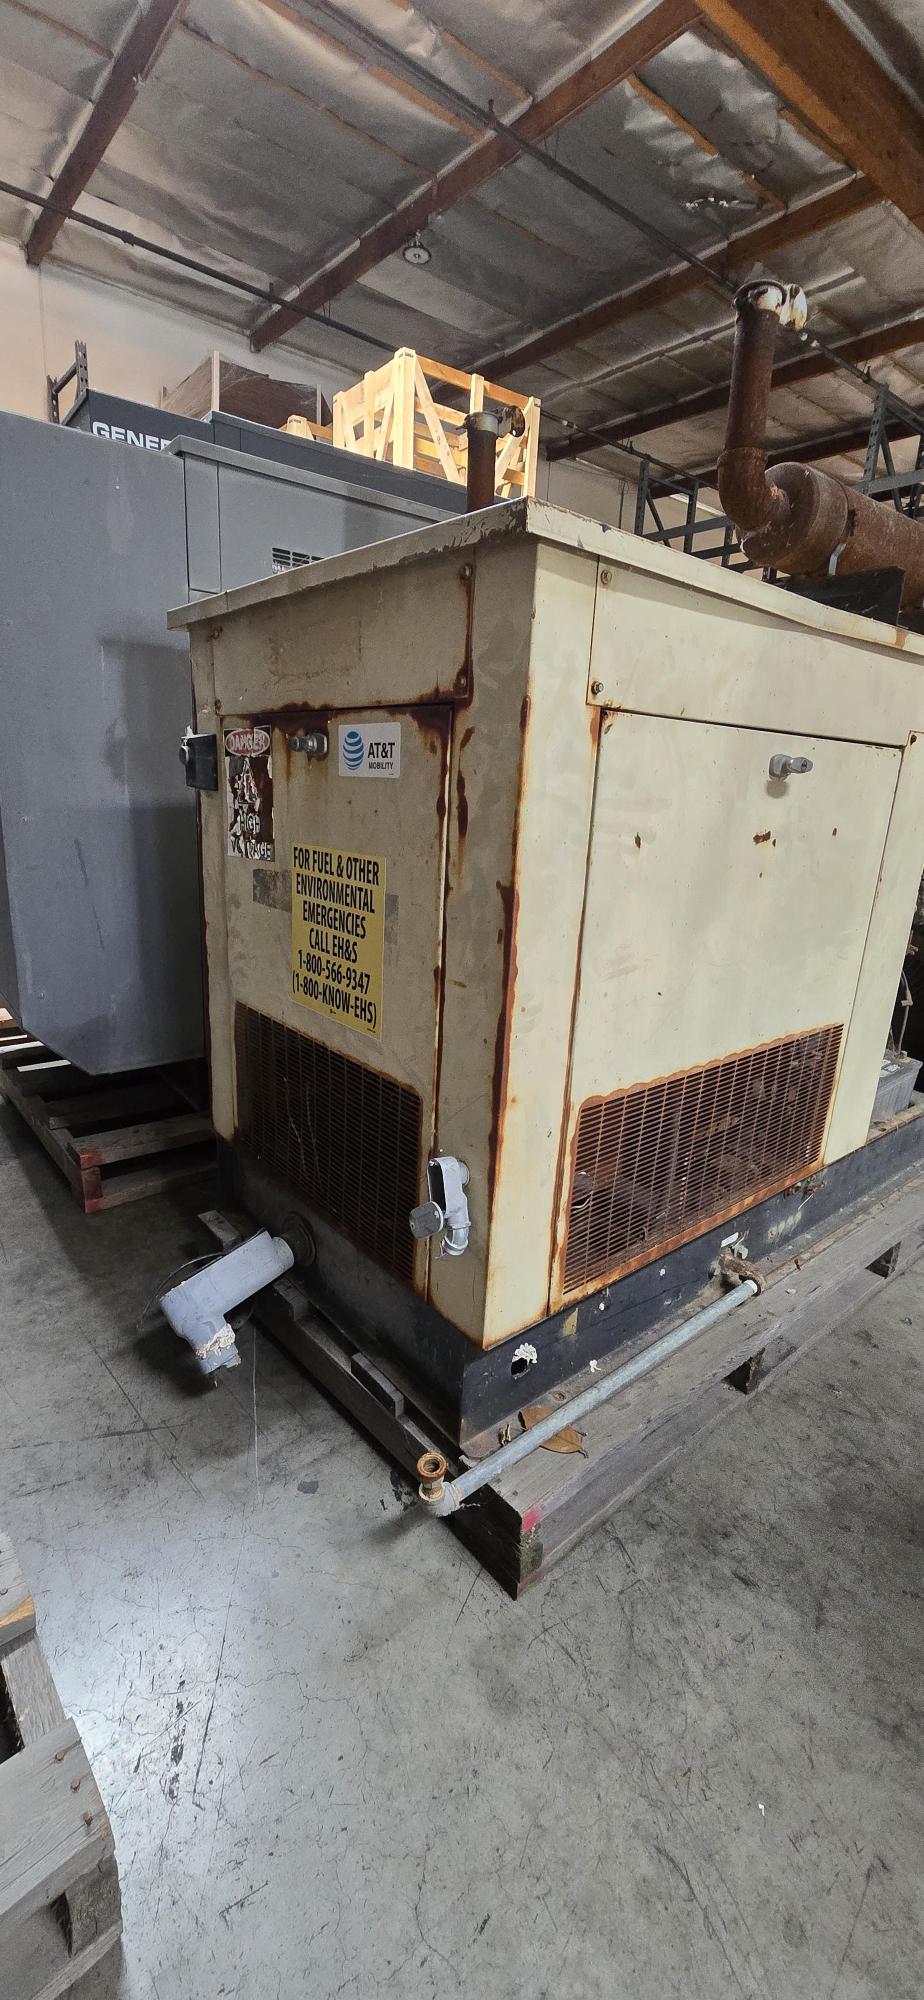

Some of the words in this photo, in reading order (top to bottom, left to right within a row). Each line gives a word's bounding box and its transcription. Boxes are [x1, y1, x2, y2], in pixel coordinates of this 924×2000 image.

[228, 733, 266, 751] DANGER
[367, 742, 396, 759] AT&T
[368, 761, 394, 770] MOBILITY
[293, 846, 311, 872] FOR
[312, 850, 335, 876] FUEL
[336, 854, 344, 879] &
[346, 856, 380, 886] OTHER
[296, 872, 376, 914] ENVIRONMENTAL
[302, 900, 367, 939] EMERGENCIES
[309, 927, 331, 955] CALL
[332, 934, 358, 964] EH&S
[298, 949, 371, 995] 1-800-566-9347
[292, 969, 377, 1030] (1-800-KNOW-EHS)
